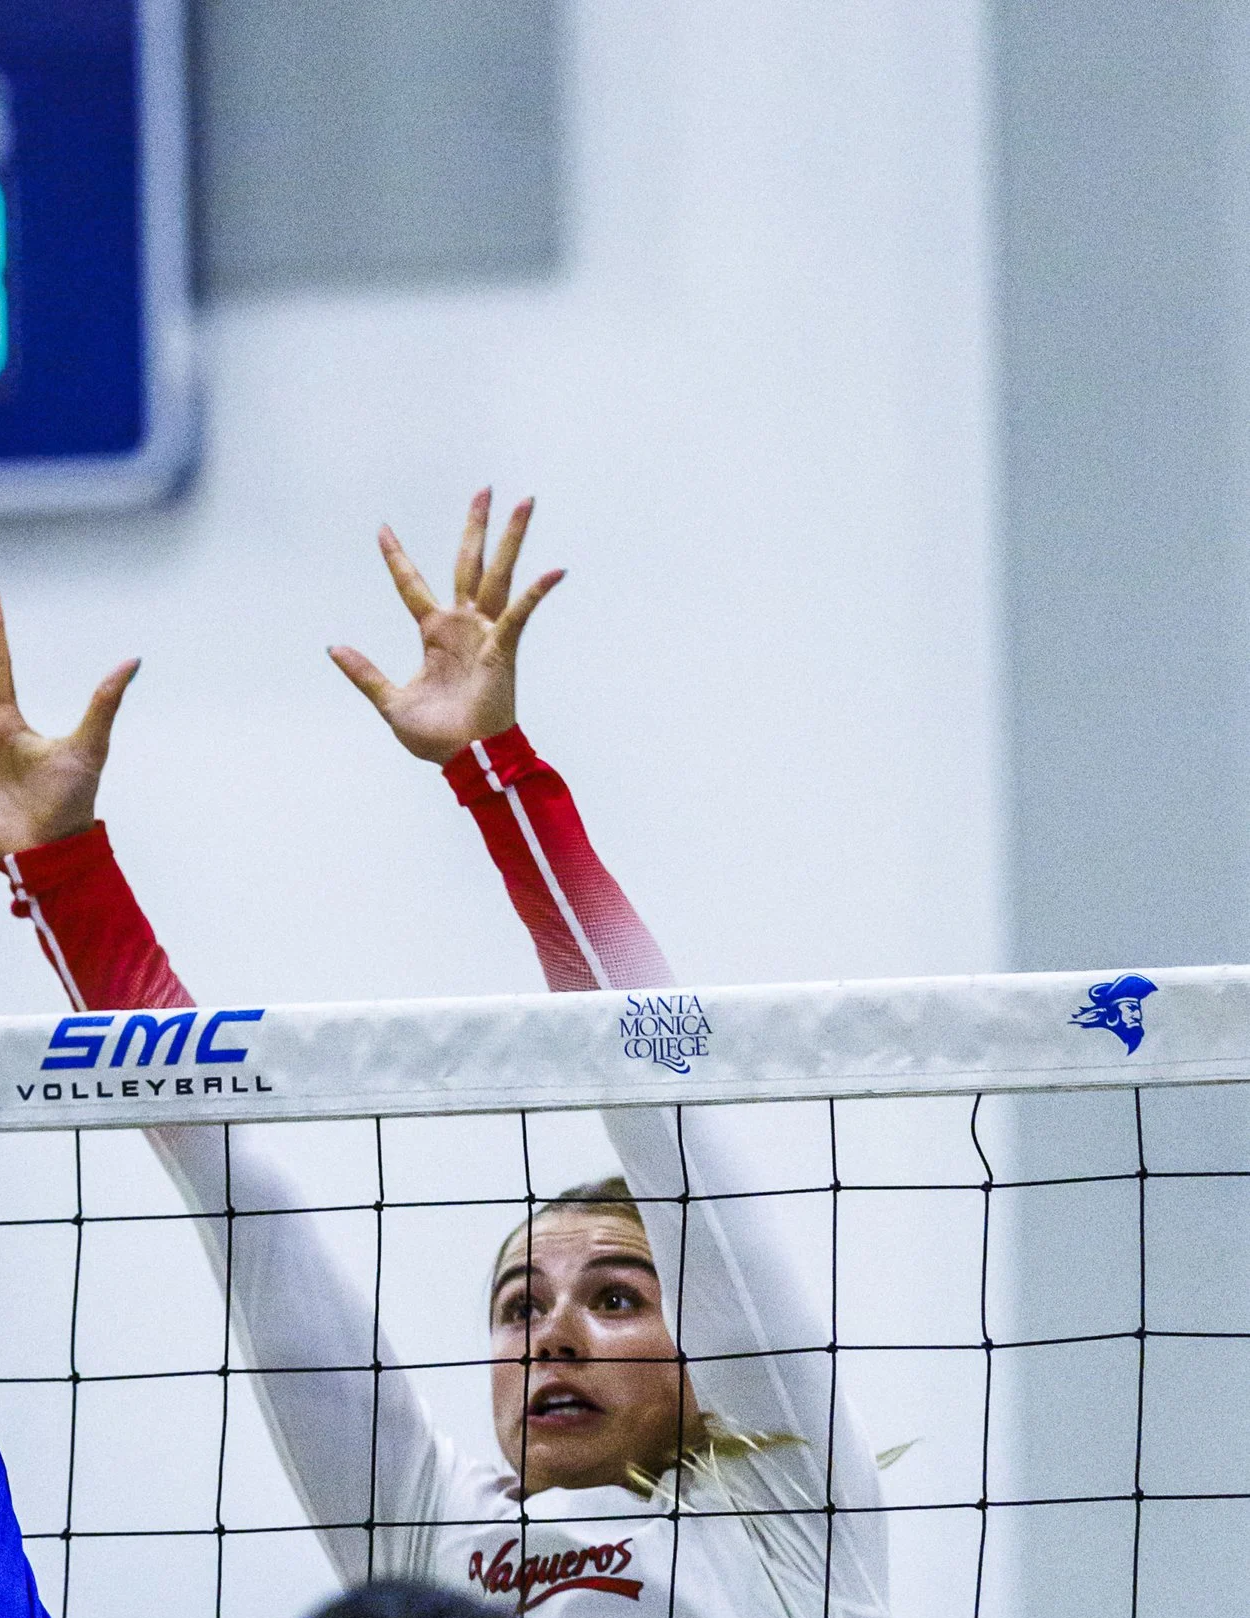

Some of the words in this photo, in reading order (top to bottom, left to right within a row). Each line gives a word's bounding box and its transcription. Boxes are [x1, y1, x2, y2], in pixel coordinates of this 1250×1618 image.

[626, 994, 704, 1016] SANTA
[40, 1009, 265, 1070] SMC
[619, 1015, 713, 1038] MONICA
[624, 1036, 709, 1074] COLLEGE
[17, 1076, 272, 1100] VOLLEYBALL
[469, 1538, 633, 1600] Vaqueros
